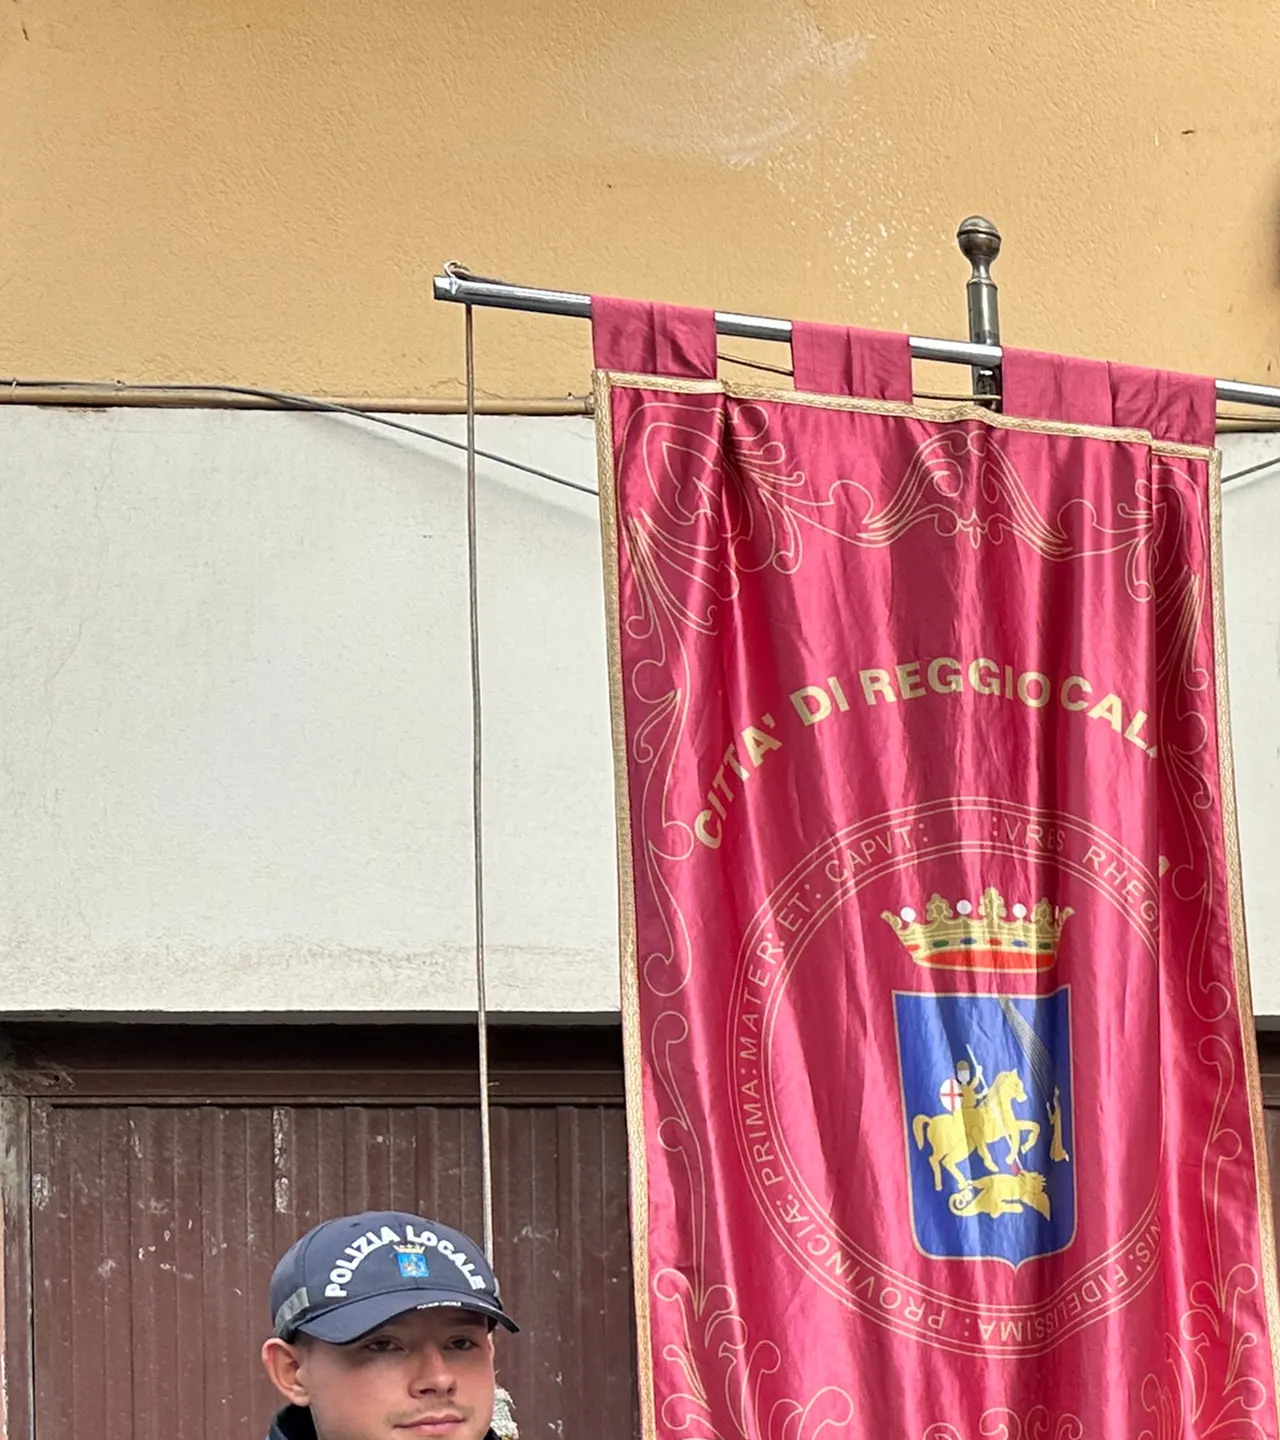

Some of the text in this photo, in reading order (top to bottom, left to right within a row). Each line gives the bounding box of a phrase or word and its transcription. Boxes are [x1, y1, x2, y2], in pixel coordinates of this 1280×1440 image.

[694, 657, 1158, 851] CITTA' DI REGGIO CAL
[777, 884, 821, 932] ET:
[825, 823, 930, 883] CAPVT:
[1082, 844, 1160, 932] RHEG
[324, 1225, 487, 1298] POLIZIA LOCALE
